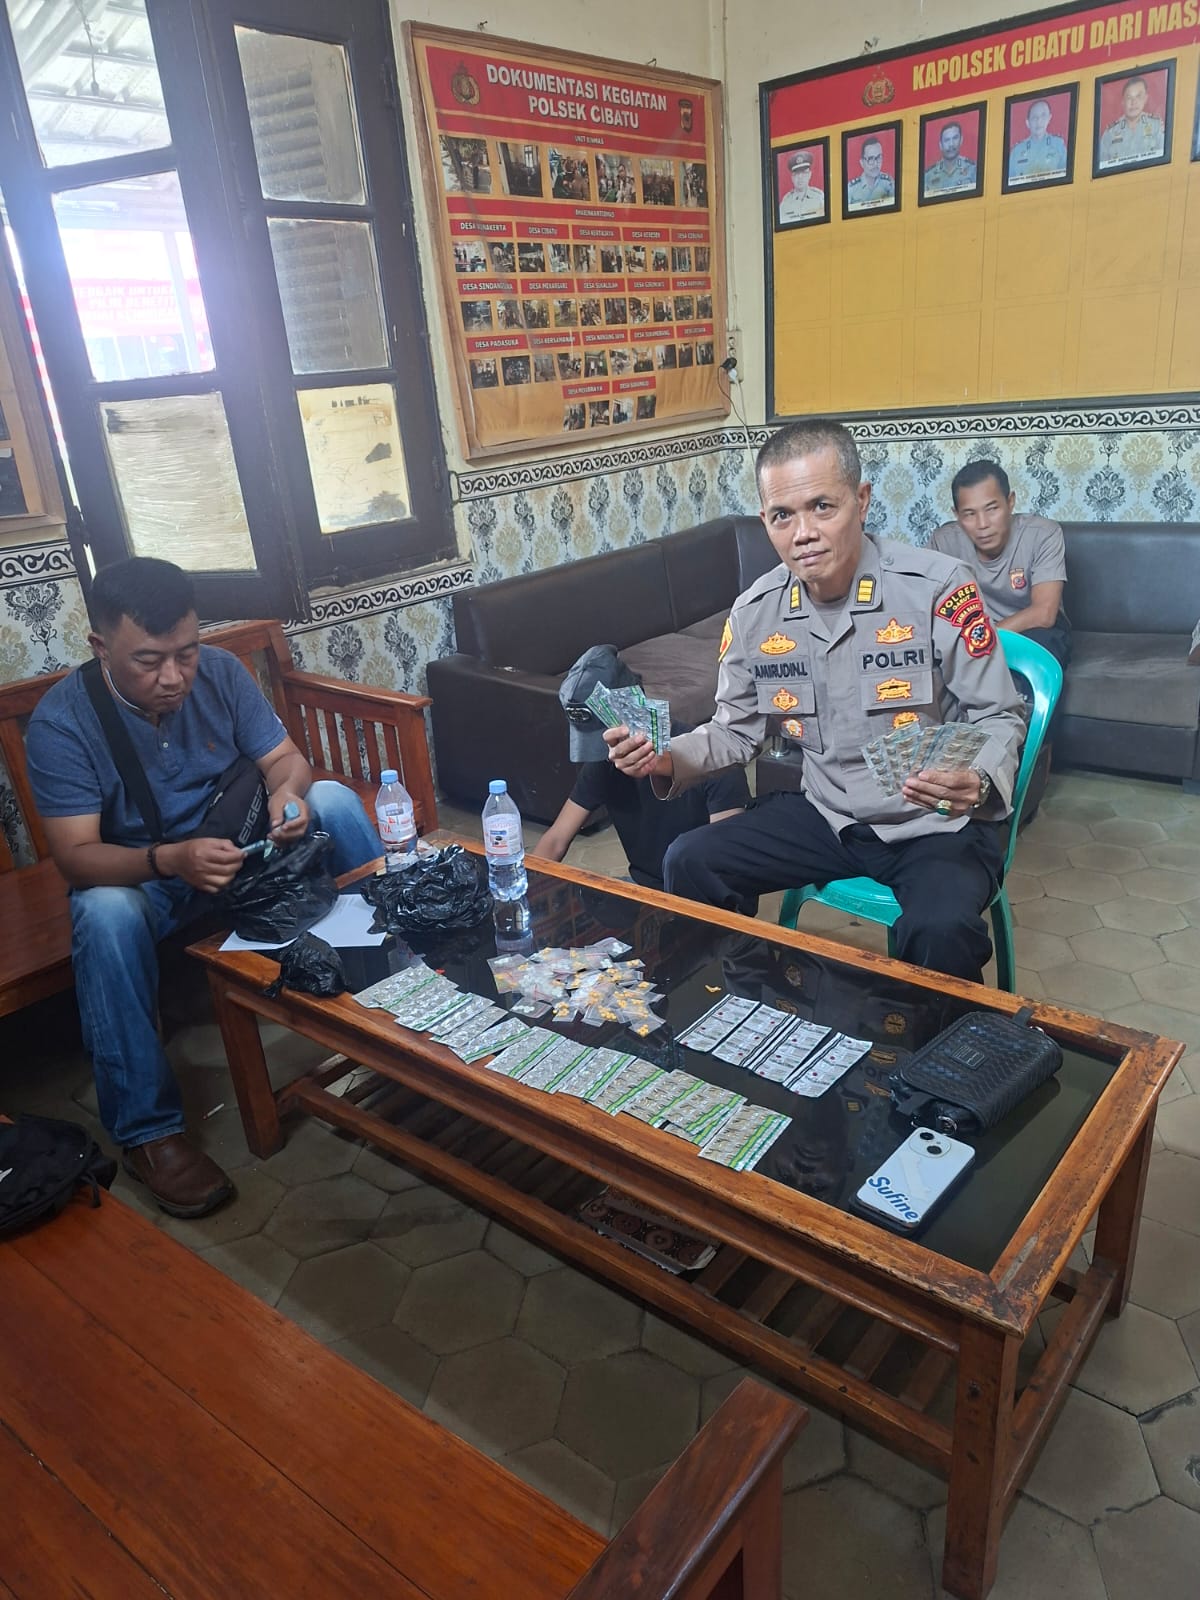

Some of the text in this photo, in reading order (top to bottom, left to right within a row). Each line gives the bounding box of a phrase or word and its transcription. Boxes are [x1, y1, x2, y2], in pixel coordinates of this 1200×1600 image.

[912, 0, 1200, 91] KAPOLSEK CIBATU DARI MAS
[486, 63, 667, 112] DOKUMENTASI KEGIATAN
[528, 95, 640, 129] POLSEK CIBATU
[460, 222, 476, 231] DESA
[462, 283, 478, 291] DESA
[475, 340, 489, 348] DESA
[939, 584, 976, 615] POLRES
[862, 648, 925, 670] POLRI
[867, 1176, 919, 1221] Sufine
